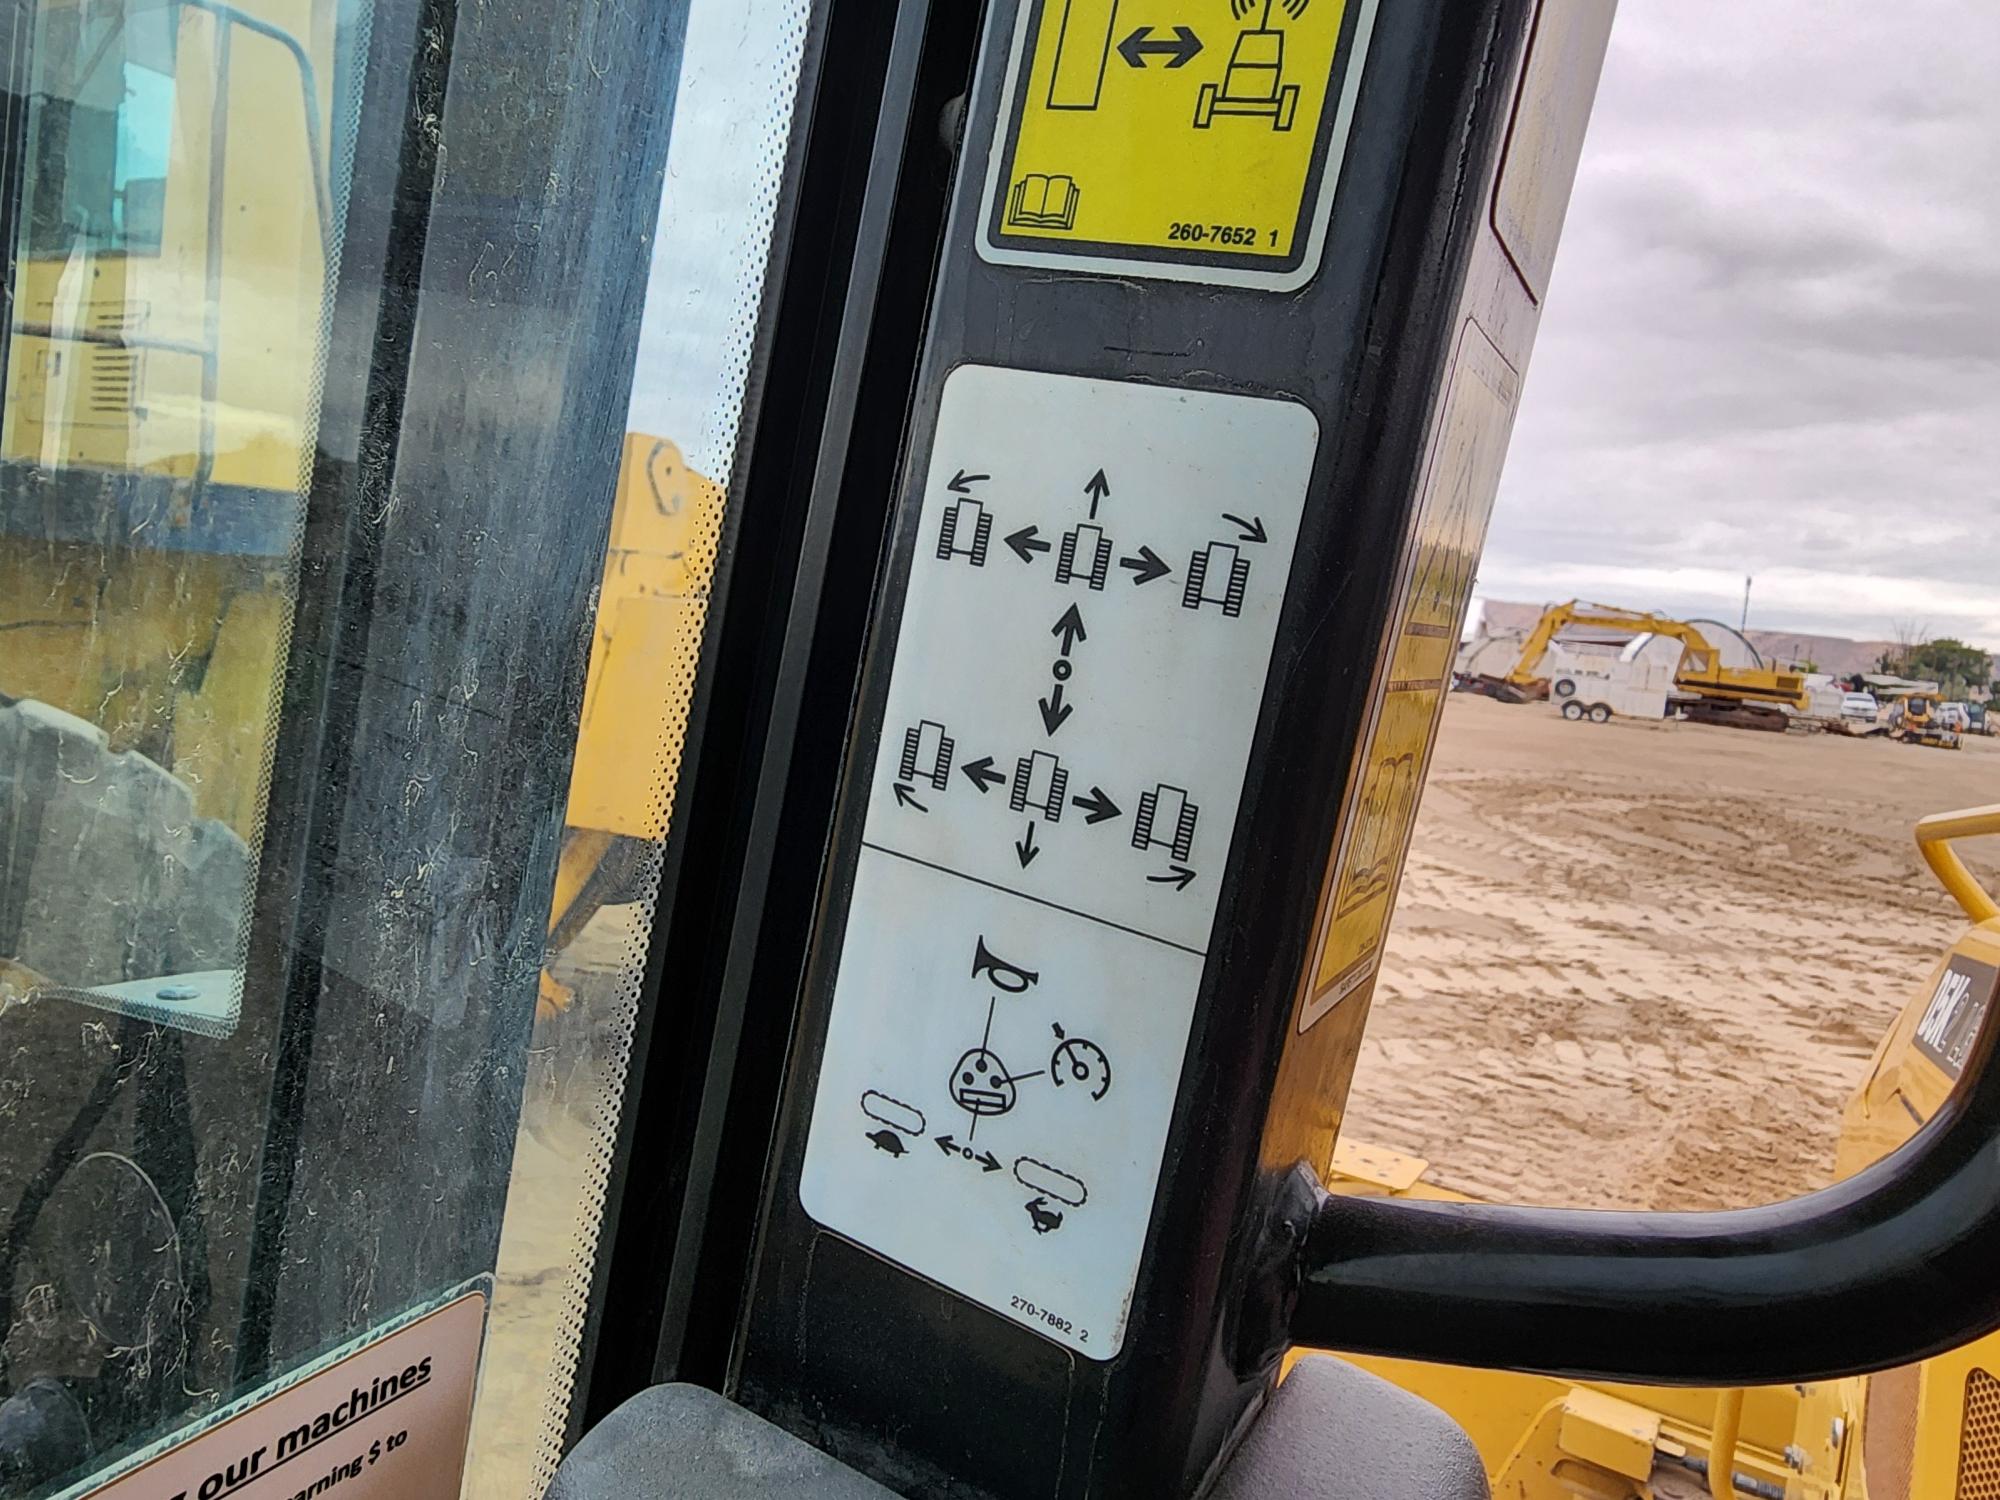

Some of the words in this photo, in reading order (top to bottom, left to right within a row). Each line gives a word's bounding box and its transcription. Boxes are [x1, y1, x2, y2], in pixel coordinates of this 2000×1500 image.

[1168, 222, 1256, 246] 260-7652
[1268, 230, 1280, 247] 1
[1010, 1295, 1073, 1335] 270-7882
[1079, 1329, 1089, 1343] 2
[198, 1446, 267, 1500] our
[276, 1356, 432, 1461] machines
[368, 1440, 380, 1466] $
[386, 1430, 408, 1452] to
